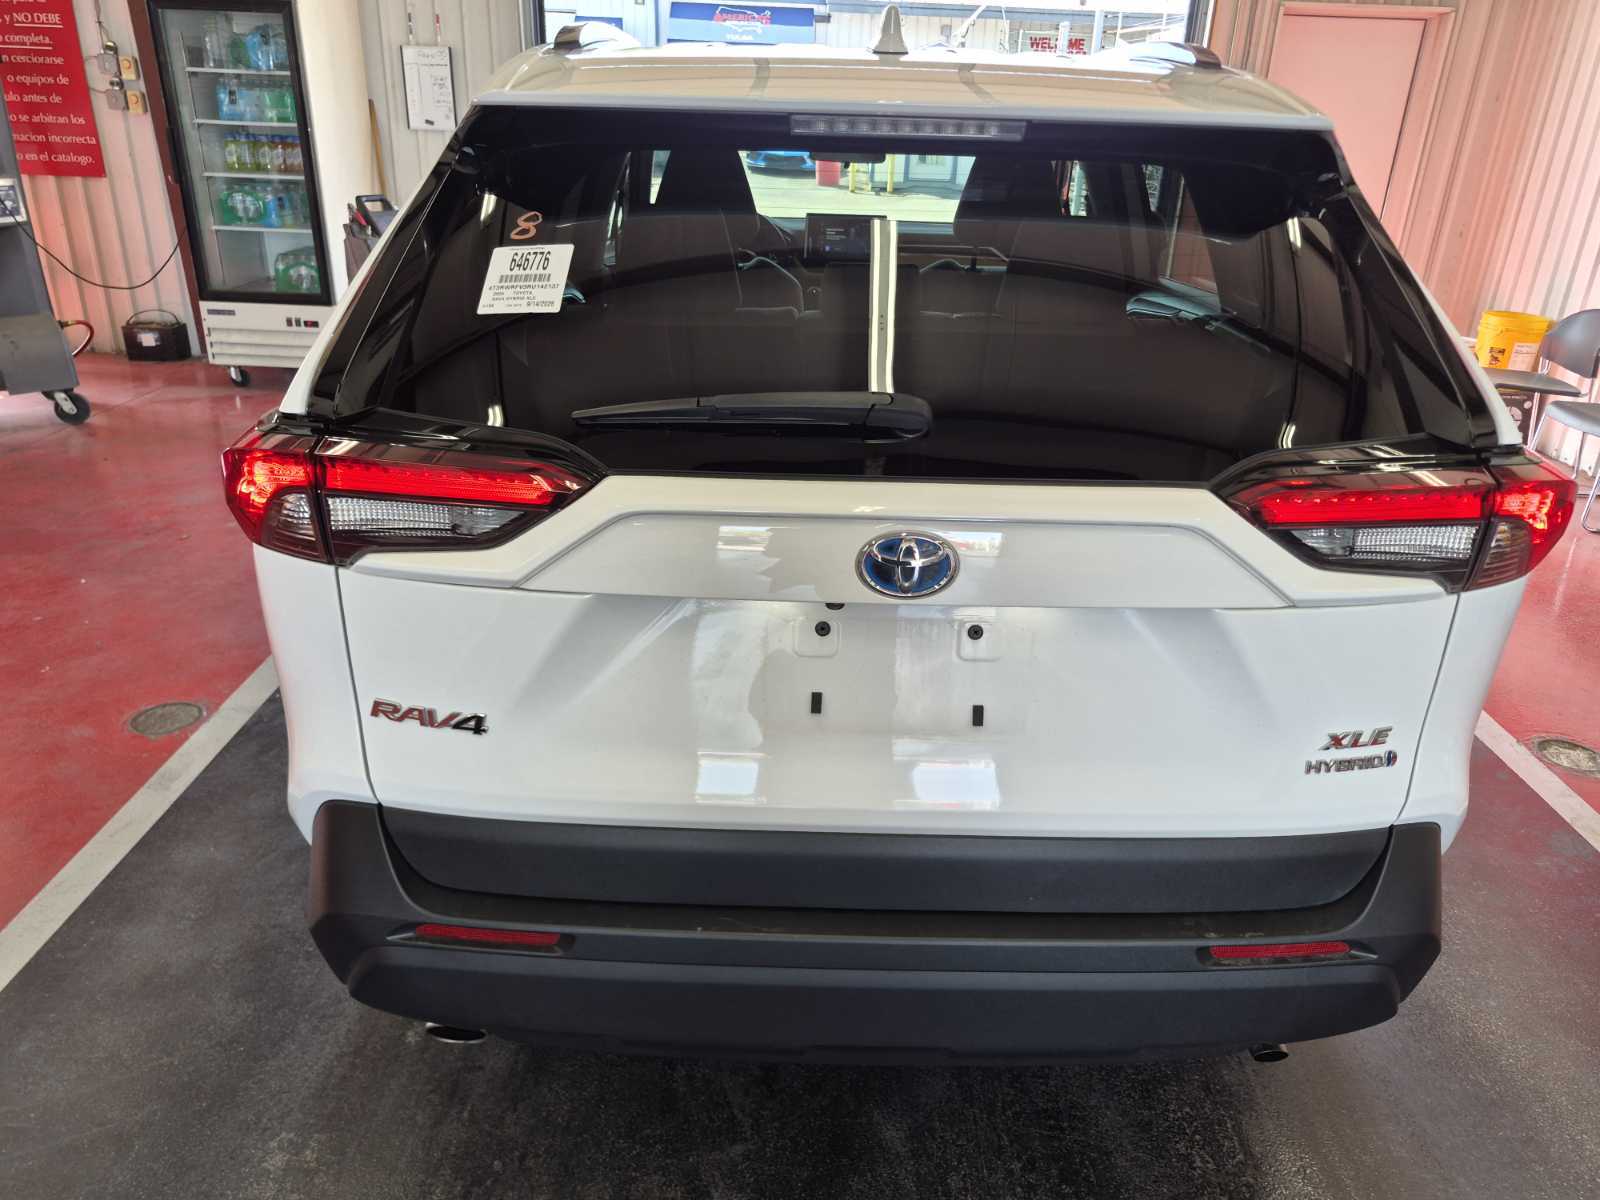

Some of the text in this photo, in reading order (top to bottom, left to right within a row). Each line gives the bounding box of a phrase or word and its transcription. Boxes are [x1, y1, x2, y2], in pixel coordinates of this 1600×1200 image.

[12, 12, 32, 23] NO
[33, 13, 63, 24] DEBE
[4, 33, 54, 46] completa.
[1029, 36, 1086, 50] WELME
[10, 54, 65, 64] cerciorarse
[16, 74, 54, 86] equipos
[56, 74, 70, 85] de
[22, 94, 48, 103] antes
[49, 93, 62, 104] de
[18, 114, 30, 122] se
[31, 112, 69, 124] arbitran
[70, 113, 86, 125] los
[48, 133, 97, 145] incorrecta
[25, 153, 38, 161] en
[39, 151, 49, 162] el
[51, 152, 96, 167] catalogo.
[510, 211, 543, 240] 8
[509, 250, 551, 272] 646776
[369, 697, 489, 735] RAV4
[1315, 725, 1394, 751] XLE
[1304, 754, 1385, 775] HYBRID
